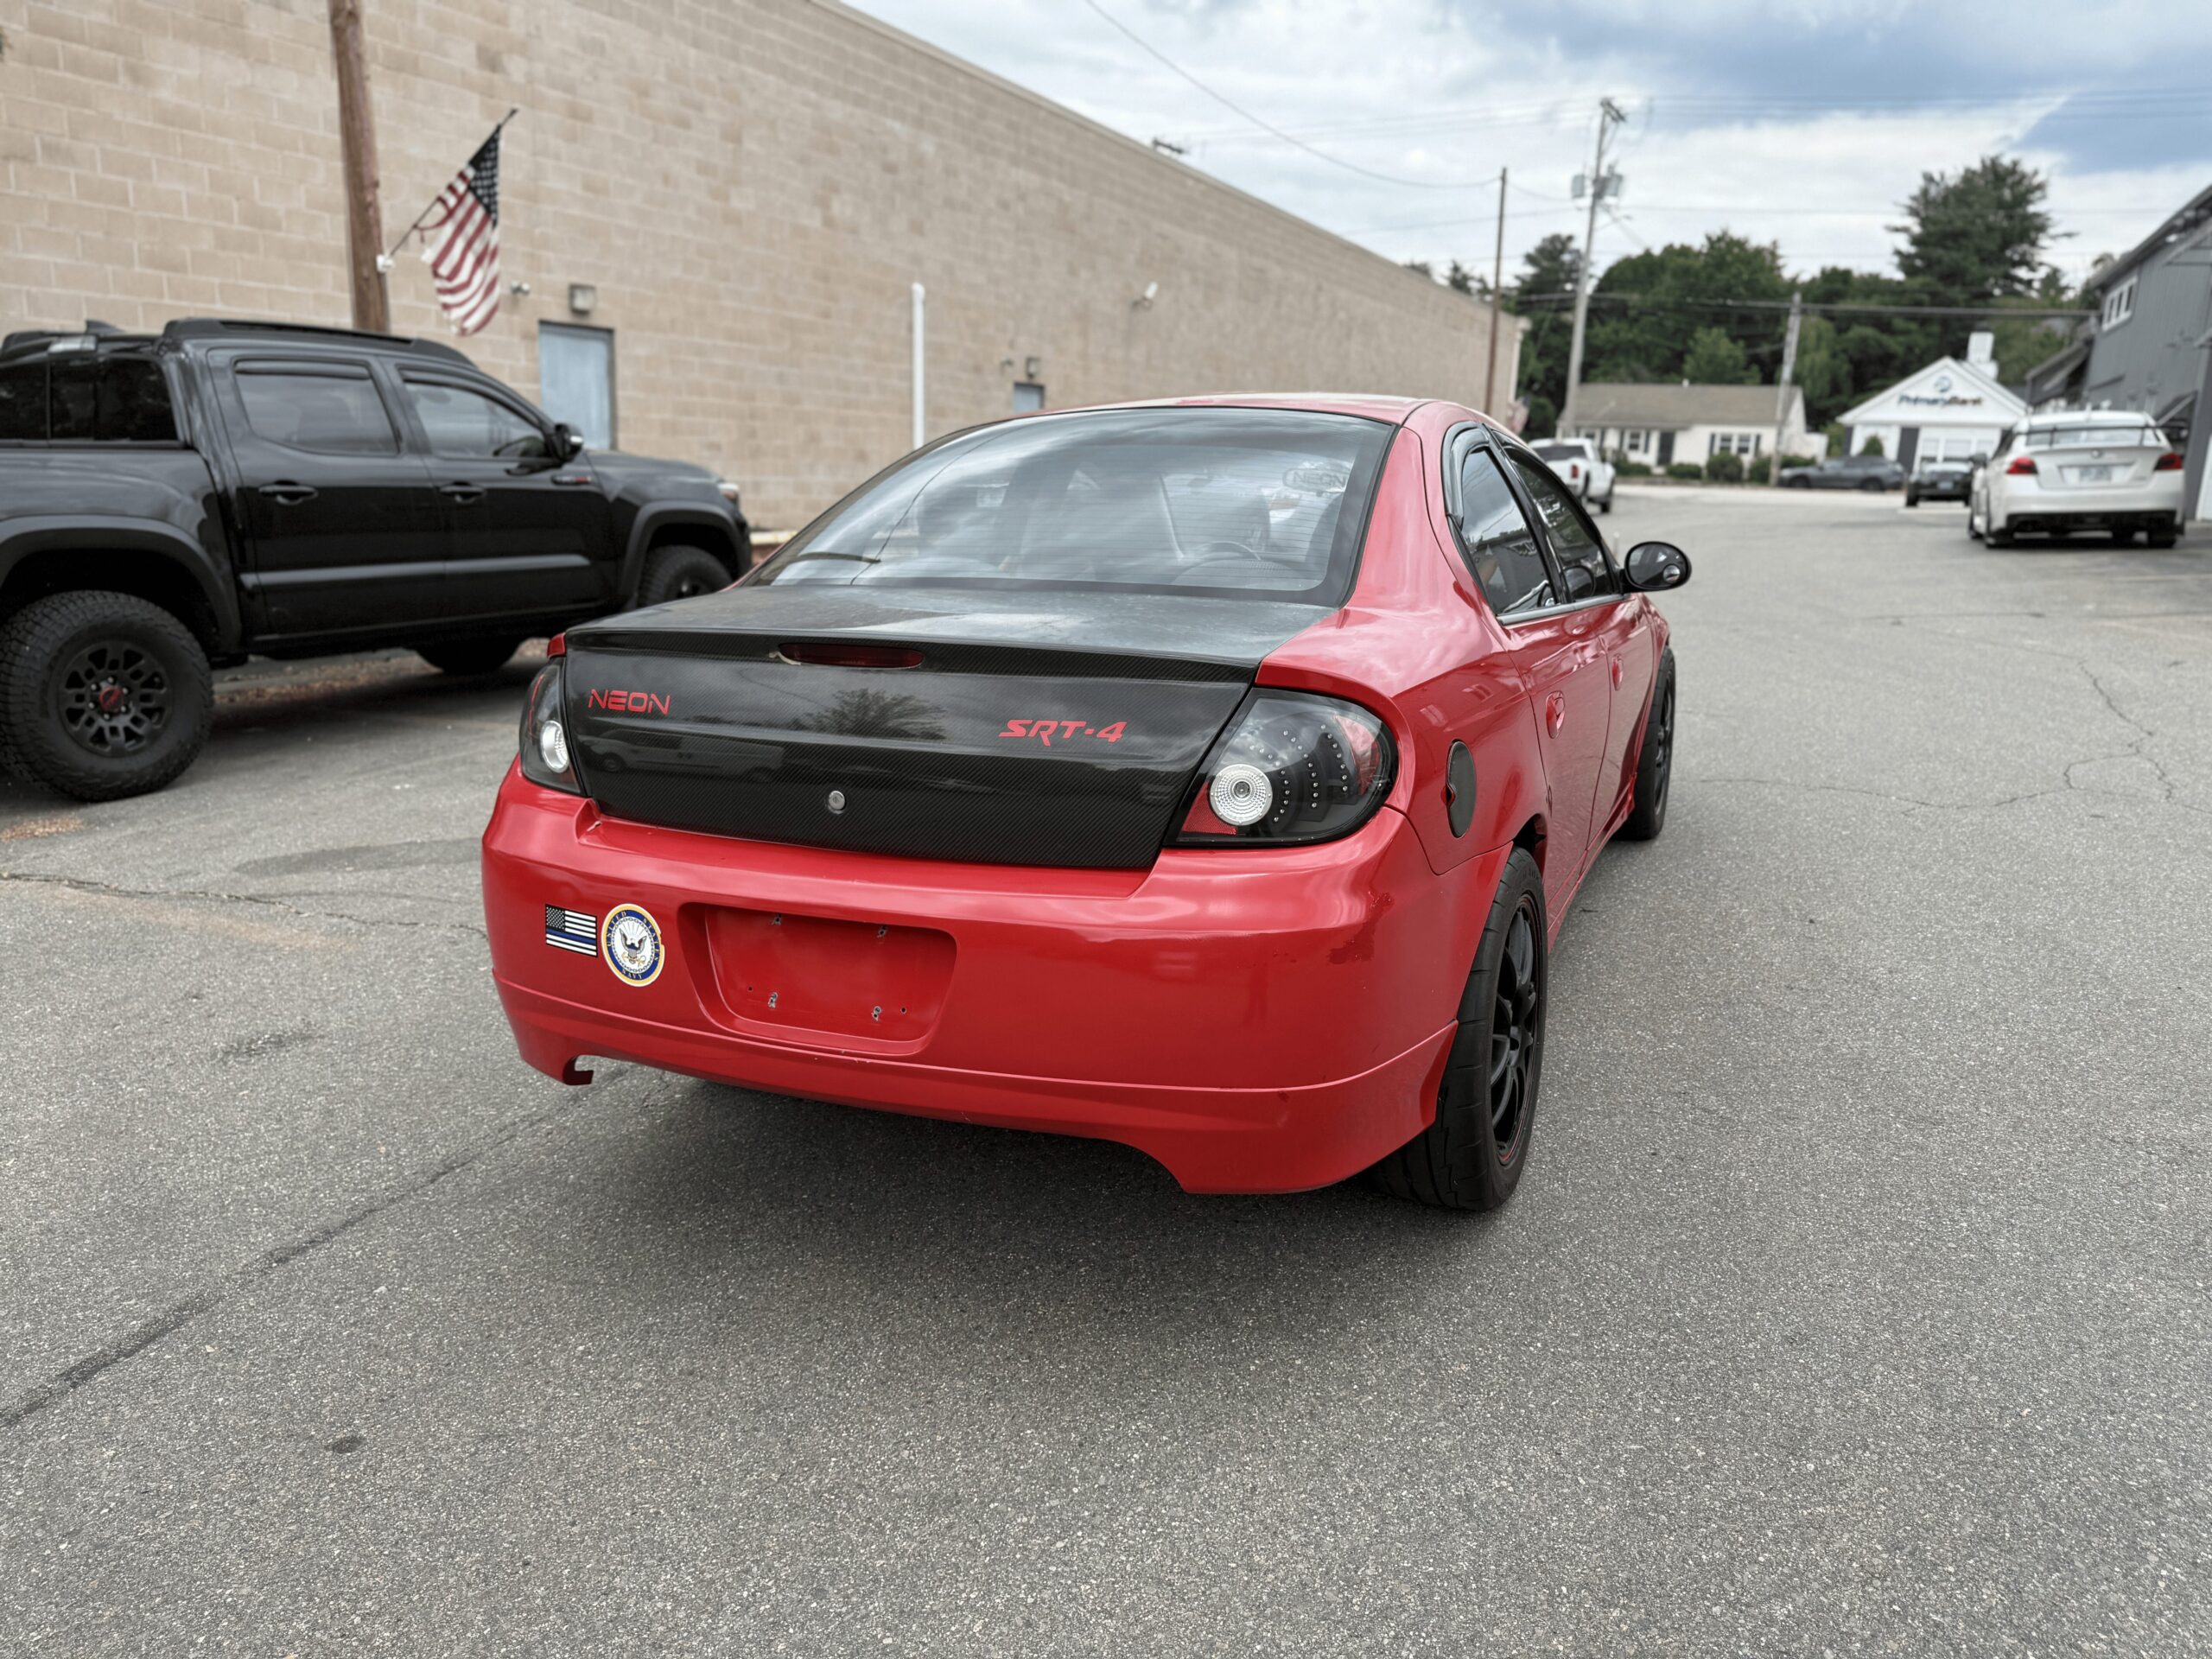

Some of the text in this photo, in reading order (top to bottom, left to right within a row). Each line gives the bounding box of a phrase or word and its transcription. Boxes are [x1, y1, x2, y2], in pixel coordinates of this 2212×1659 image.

[1293, 471, 1347, 486] NEON
[588, 689, 671, 715] NEON
[998, 719, 1128, 747] SRT-4
[607, 911, 660, 961] UNITED STATES
[621, 969, 643, 980] NAVY
